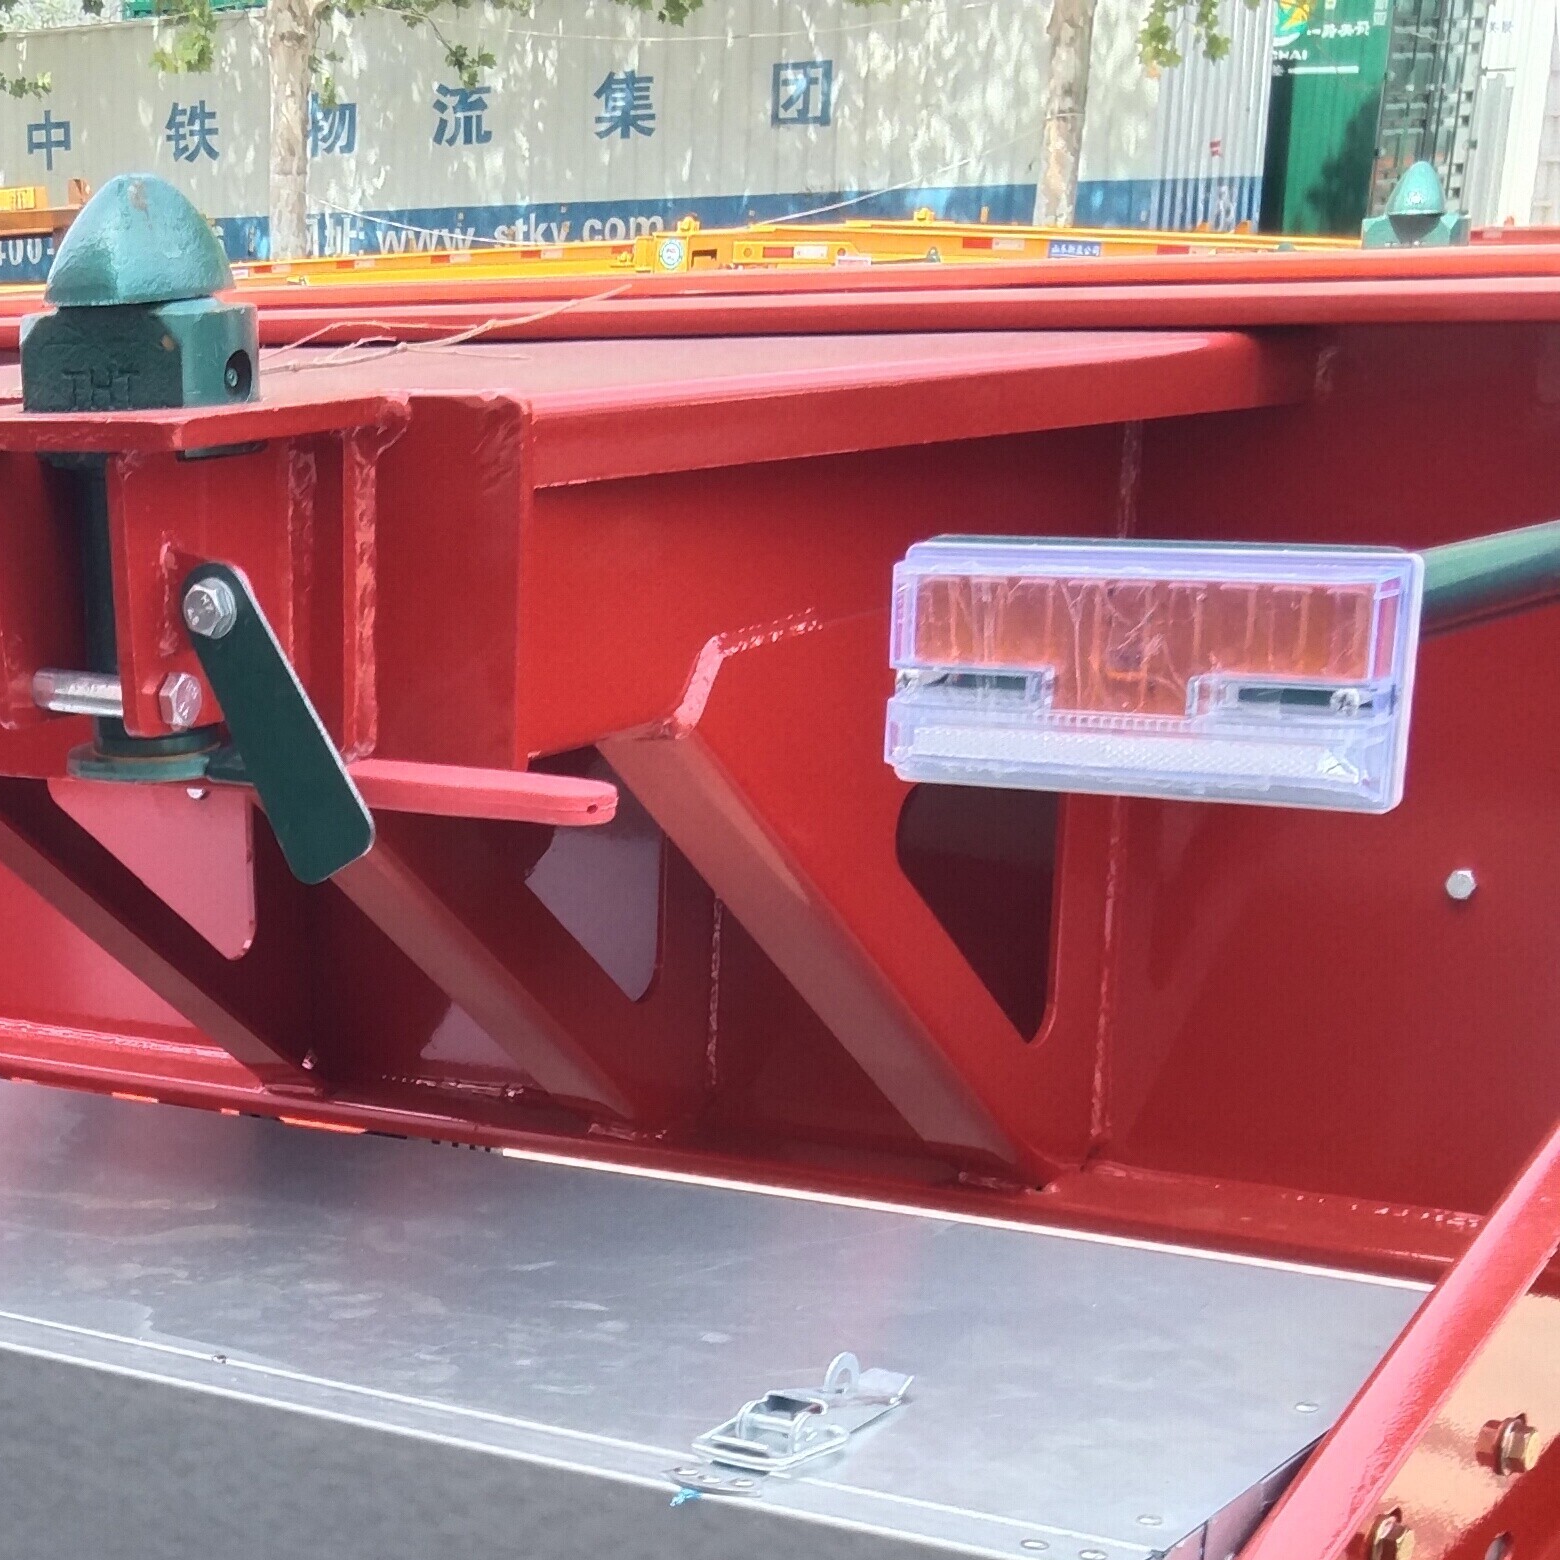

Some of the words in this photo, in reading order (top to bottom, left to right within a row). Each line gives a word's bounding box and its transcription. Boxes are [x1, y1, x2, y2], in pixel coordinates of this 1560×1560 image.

[27, 60, 833, 171] 中铁物流集团
[376, 212, 664, 253] wwwstky.com
[61, 368, 140, 412] THT
